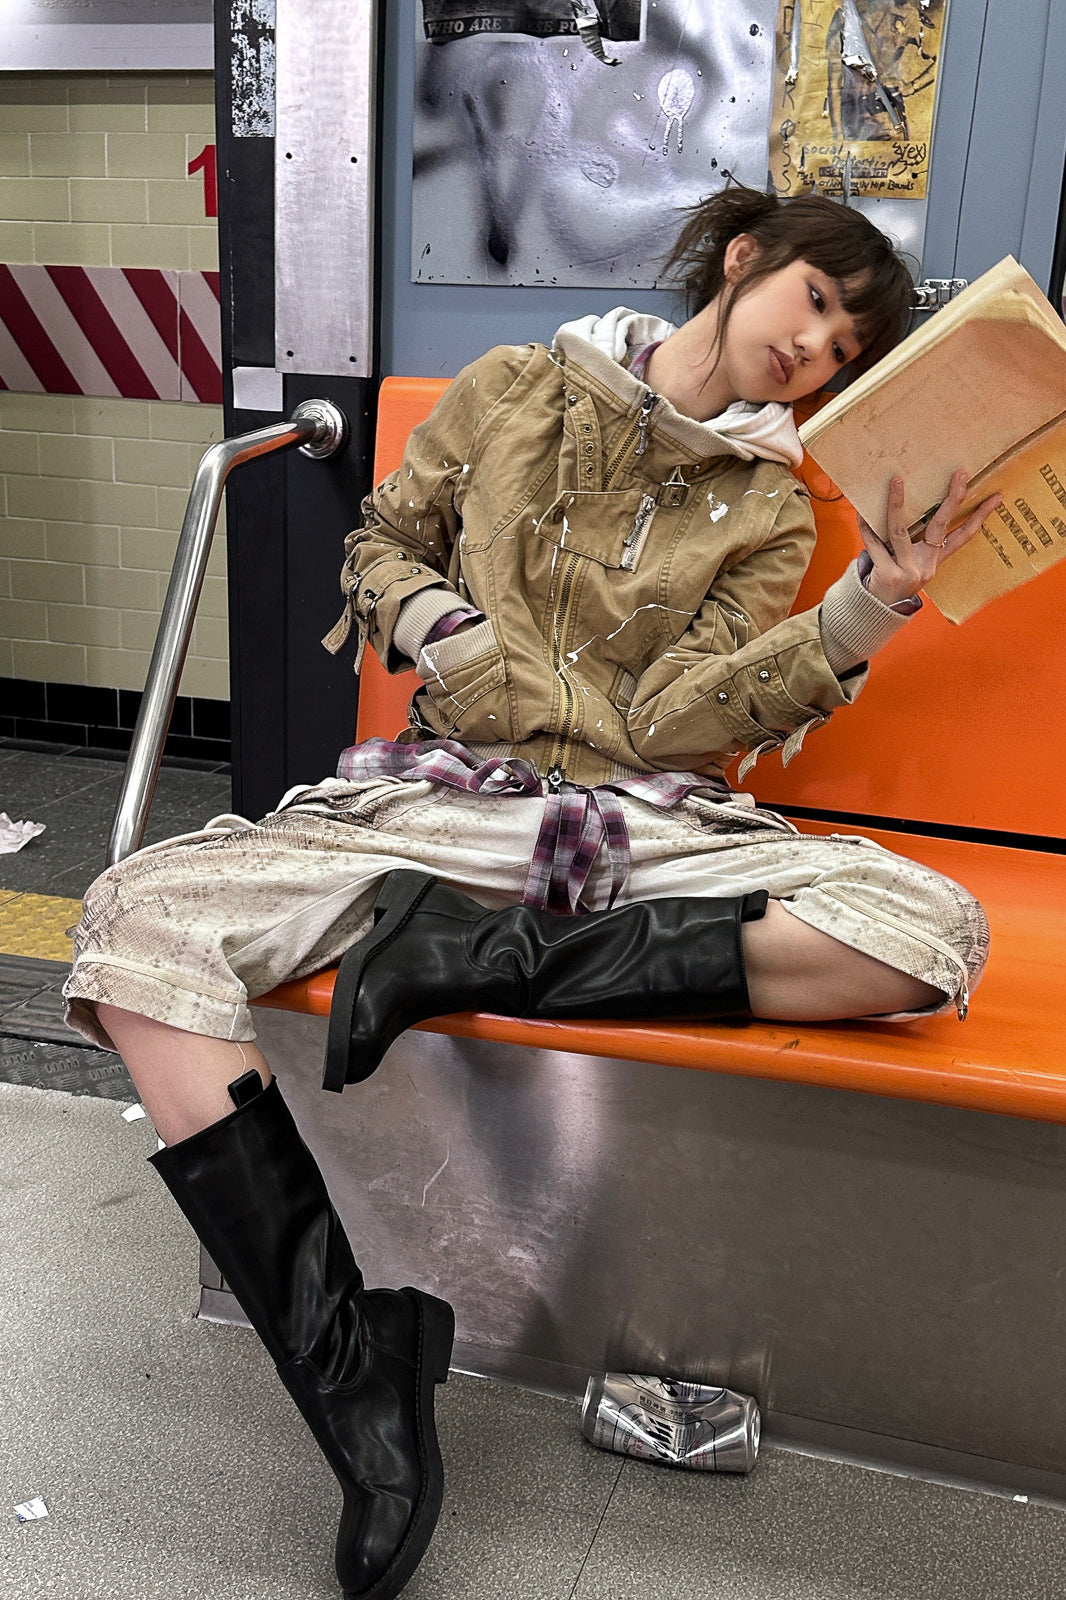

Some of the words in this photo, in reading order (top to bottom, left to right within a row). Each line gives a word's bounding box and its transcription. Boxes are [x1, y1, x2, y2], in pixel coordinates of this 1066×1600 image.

[427, 20, 465, 36] WHO
[468, 17, 503, 32] ARE
[507, 18, 554, 34] TSE
[804, 142, 843, 156] Social
[188, 144, 218, 218] 1
[888, 179, 914, 191] Bands
[1014, 497, 1054, 549] COMPUTER
